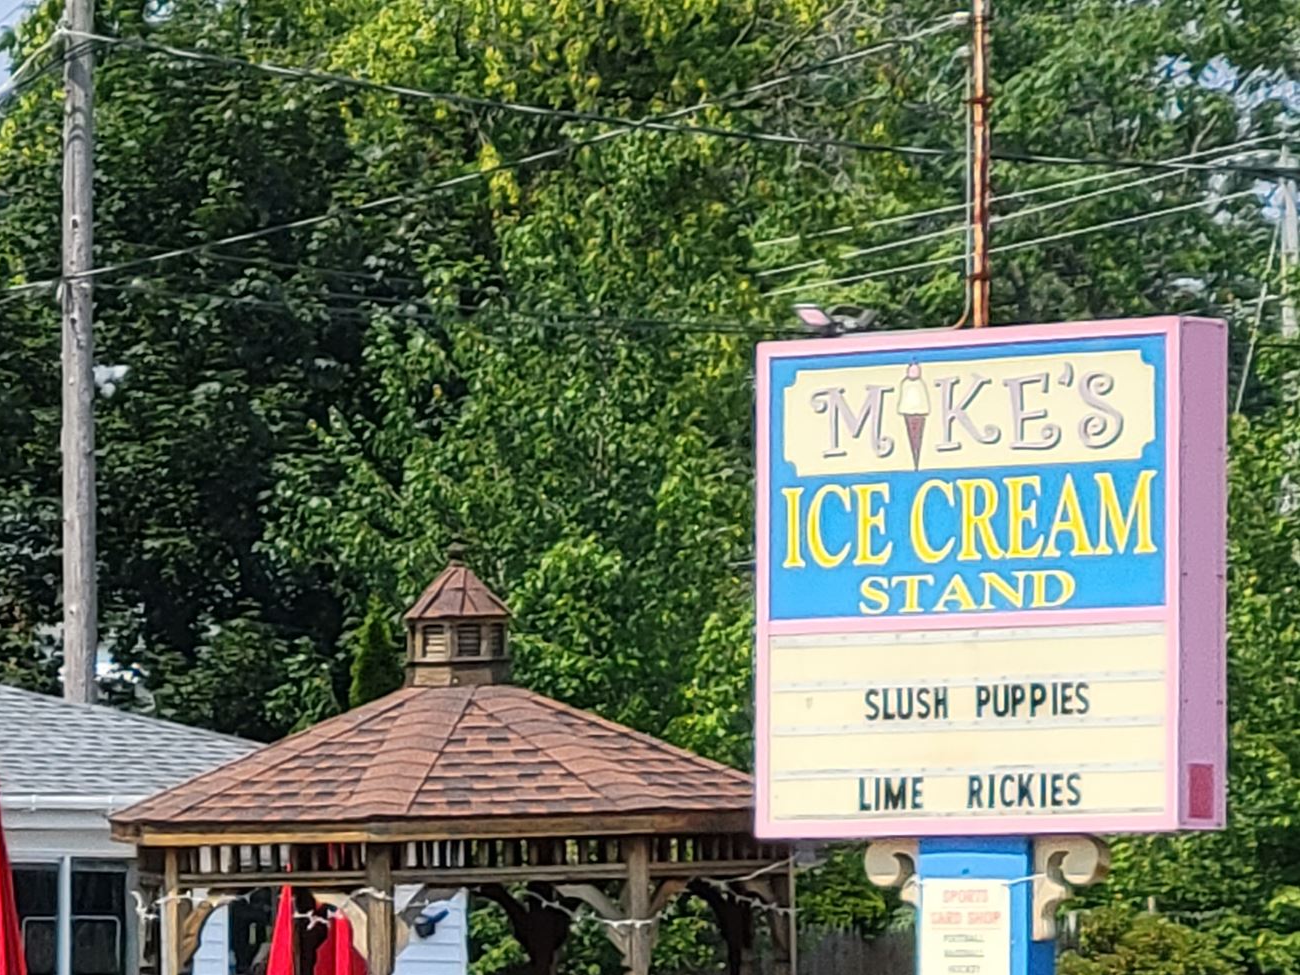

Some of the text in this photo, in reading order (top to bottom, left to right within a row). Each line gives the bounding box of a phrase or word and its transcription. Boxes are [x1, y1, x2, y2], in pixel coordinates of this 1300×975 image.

[781, 469, 1159, 570] ICE CREAM
[858, 569, 1077, 615] STAND
[864, 682, 1090, 720] SLUSH PUPPIES
[858, 772, 1082, 811] LIME RICKIES
